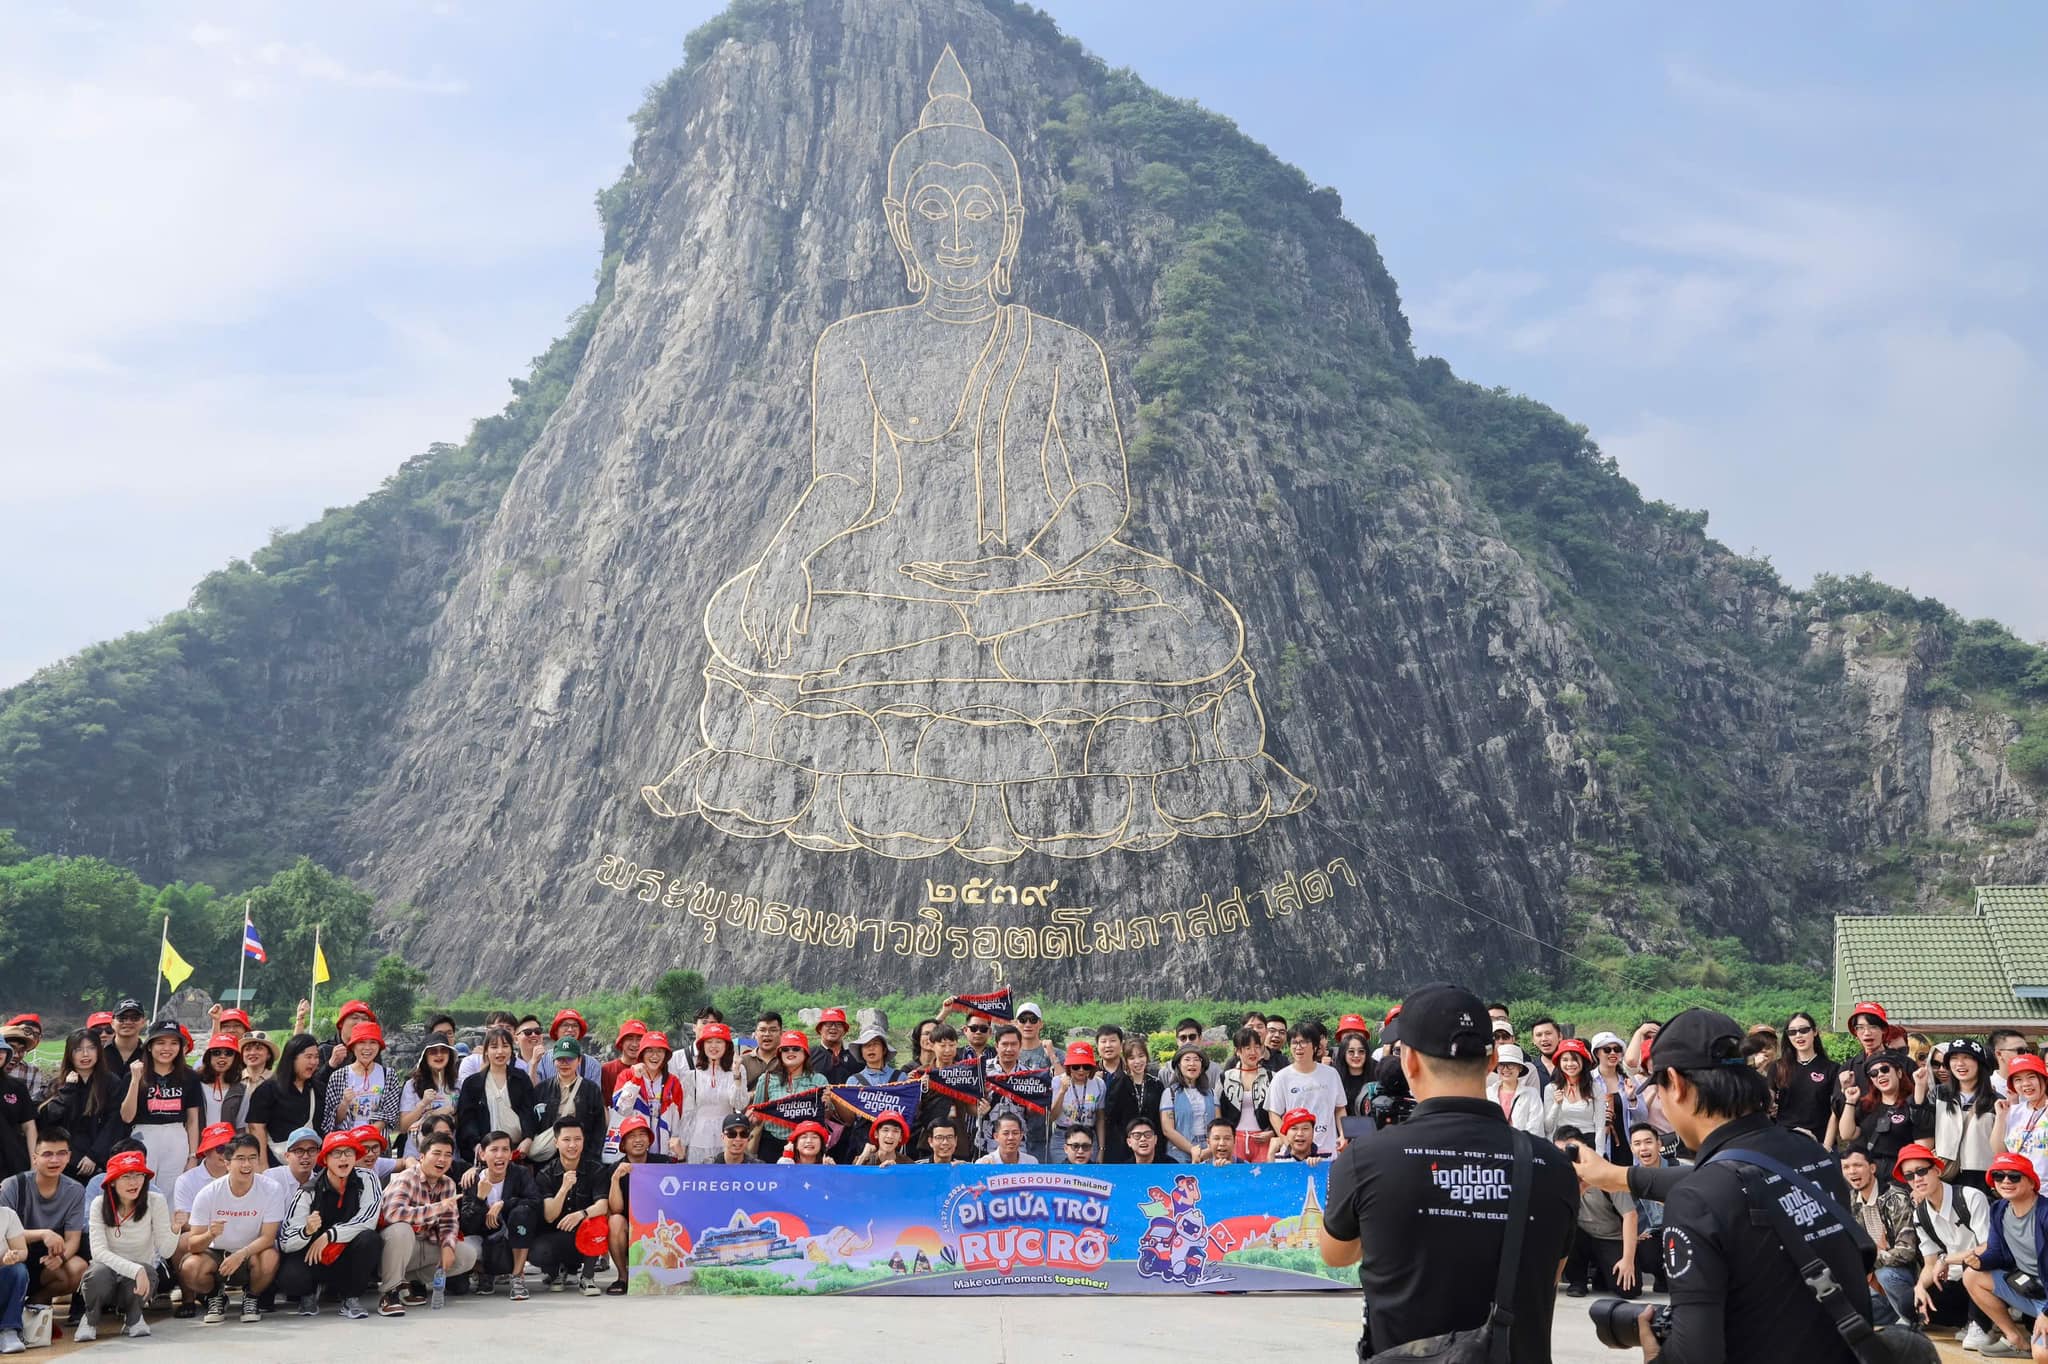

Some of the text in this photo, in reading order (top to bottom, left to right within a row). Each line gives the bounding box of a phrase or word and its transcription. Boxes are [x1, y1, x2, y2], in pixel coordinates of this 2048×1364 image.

[926, 877, 1058, 906] ๒๕๓๙
[939, 1067, 972, 1080] ignition
[945, 1075, 979, 1086] agency
[1006, 1074, 1041, 1087] agency
[1013, 1083, 1047, 1095] ignition
[857, 1088, 900, 1105] ignition
[777, 1100, 812, 1113] ignition
[783, 1106, 818, 1119] agency
[864, 1100, 906, 1115] agency
[990, 1176, 1062, 1188] FIREGROUP
[1431, 1162, 1506, 1189] ignition
[682, 1180, 778, 1192] FIREGROUP
[958, 1191, 1110, 1226] ĐI GIỮA TRỜI
[961, 1228, 1108, 1270] RỰC RỠ
[953, 1275, 1109, 1290] Make our moments together!
